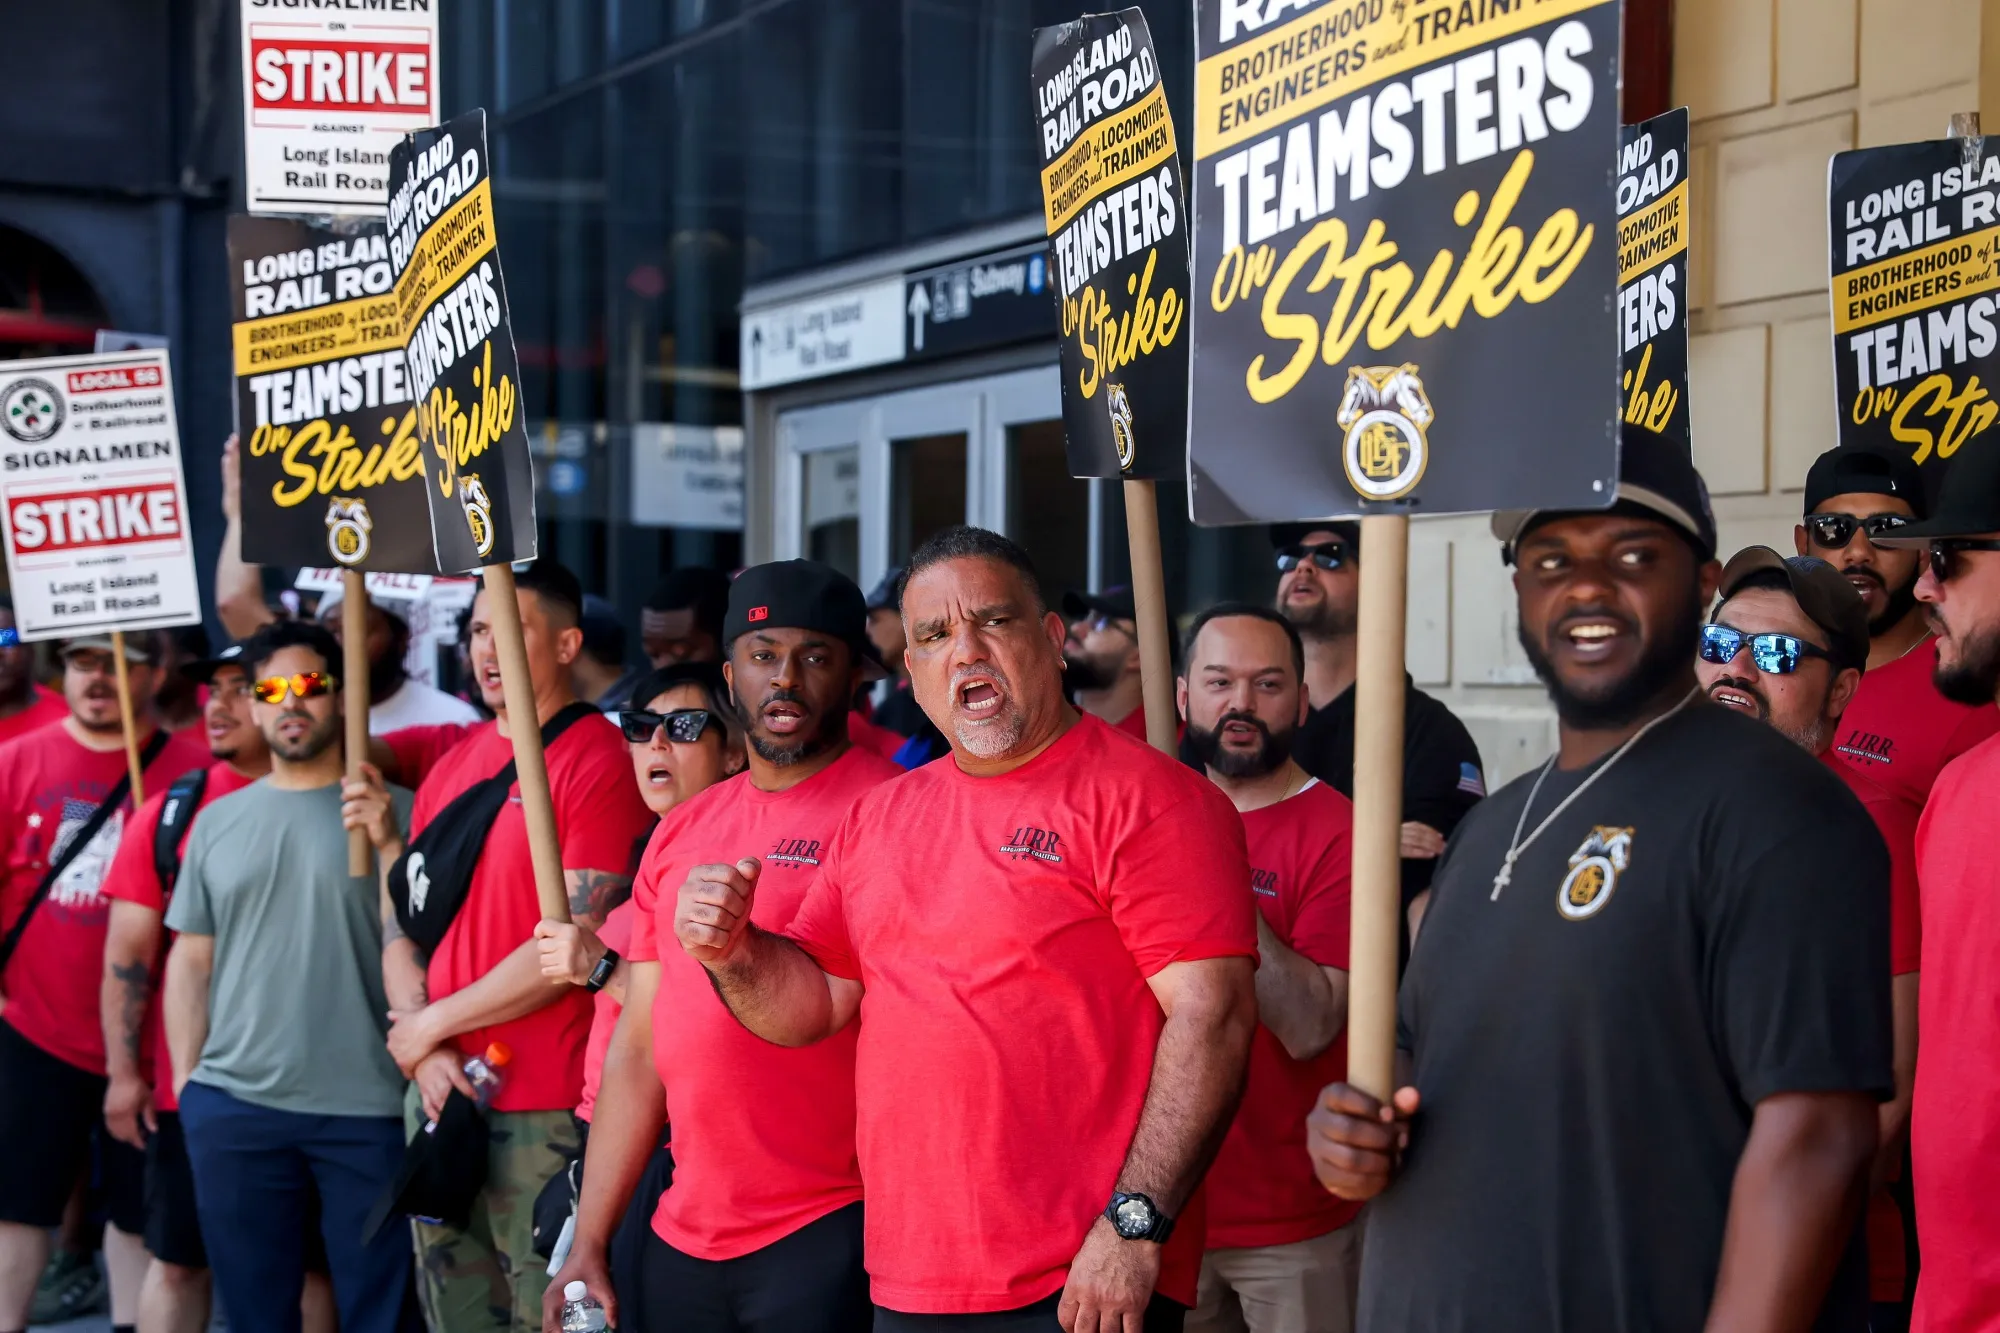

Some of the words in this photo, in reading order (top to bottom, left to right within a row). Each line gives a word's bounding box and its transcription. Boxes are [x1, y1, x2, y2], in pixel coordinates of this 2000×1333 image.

[255, 47, 427, 106] STRIKE
[1039, 64, 1073, 118] LONG
[1073, 24, 1132, 89] ISLAND
[1220, 0, 1383, 96] BROTHERHOOD
[1043, 96, 1082, 160] RAIL
[1081, 46, 1155, 124] ROAD
[1218, 40, 1367, 134] ENGINEERS
[283, 146, 329, 167] Long
[336, 148, 391, 165] Islan
[312, 124, 365, 133] AGAINST
[1050, 140, 1091, 195] BROTHERHOOD
[1101, 96, 1165, 152] LOCOMOTIVE
[1215, 20, 1594, 256] TEAMSTERS
[285, 171, 328, 189] Rail
[336, 173, 390, 191] Roa
[413, 148, 479, 233] ROAD
[1052, 170, 1089, 221] ENGINEERS
[1102, 123, 1168, 178] TRAINMEN
[1616, 149, 1679, 215] OAD
[1846, 179, 1925, 229] LONG
[1932, 155, 2000, 202] ISLA
[432, 194, 483, 256] LOCOMOTIVE
[436, 221, 486, 280] TRAINMEN
[1055, 166, 1176, 300] TEAMSTERS
[1618, 221, 1679, 276] RAINMEN
[1846, 206, 1951, 267] RAIL
[243, 248, 315, 287] LONG
[317, 234, 389, 272] ISLAN
[245, 274, 331, 319] RAIL
[335, 261, 394, 300] RO
[969, 262, 1027, 298] Subway
[1211, 244, 1277, 312] On
[1246, 149, 1595, 404] Strike
[1848, 244, 1972, 298] BROTHERHOOD
[1977, 241, 1990, 264] of
[1848, 271, 1961, 321] ENGINEERS
[1965, 264, 1991, 285] and
[249, 311, 345, 344] BROTHERHOOD
[250, 335, 336, 364] ENGINEERS
[361, 321, 400, 344] TRAI
[407, 261, 500, 408] TEAMSTERS
[1063, 295, 1079, 337] On
[1079, 248, 1183, 399] Strike
[1850, 296, 2000, 391] TEAMS
[249, 350, 414, 427] TEAMSTE
[430, 339, 514, 498] Strike
[1853, 385, 1898, 425] On
[1890, 373, 1999, 467] Str
[5, 441, 171, 471] SIGNALMEN
[250, 424, 292, 457] On
[272, 405, 427, 508] Strik
[12, 489, 179, 549] STRIKE
[50, 580, 95, 595] Long
[101, 572, 158, 589] Island
[53, 600, 96, 615] Rail
[105, 594, 160, 610] Road
[1846, 730, 1893, 756] LIRR
[774, 839, 821, 857] LIRR
[1008, 827, 1060, 853] LIRR
[1031, 850, 1060, 862] COALITION
